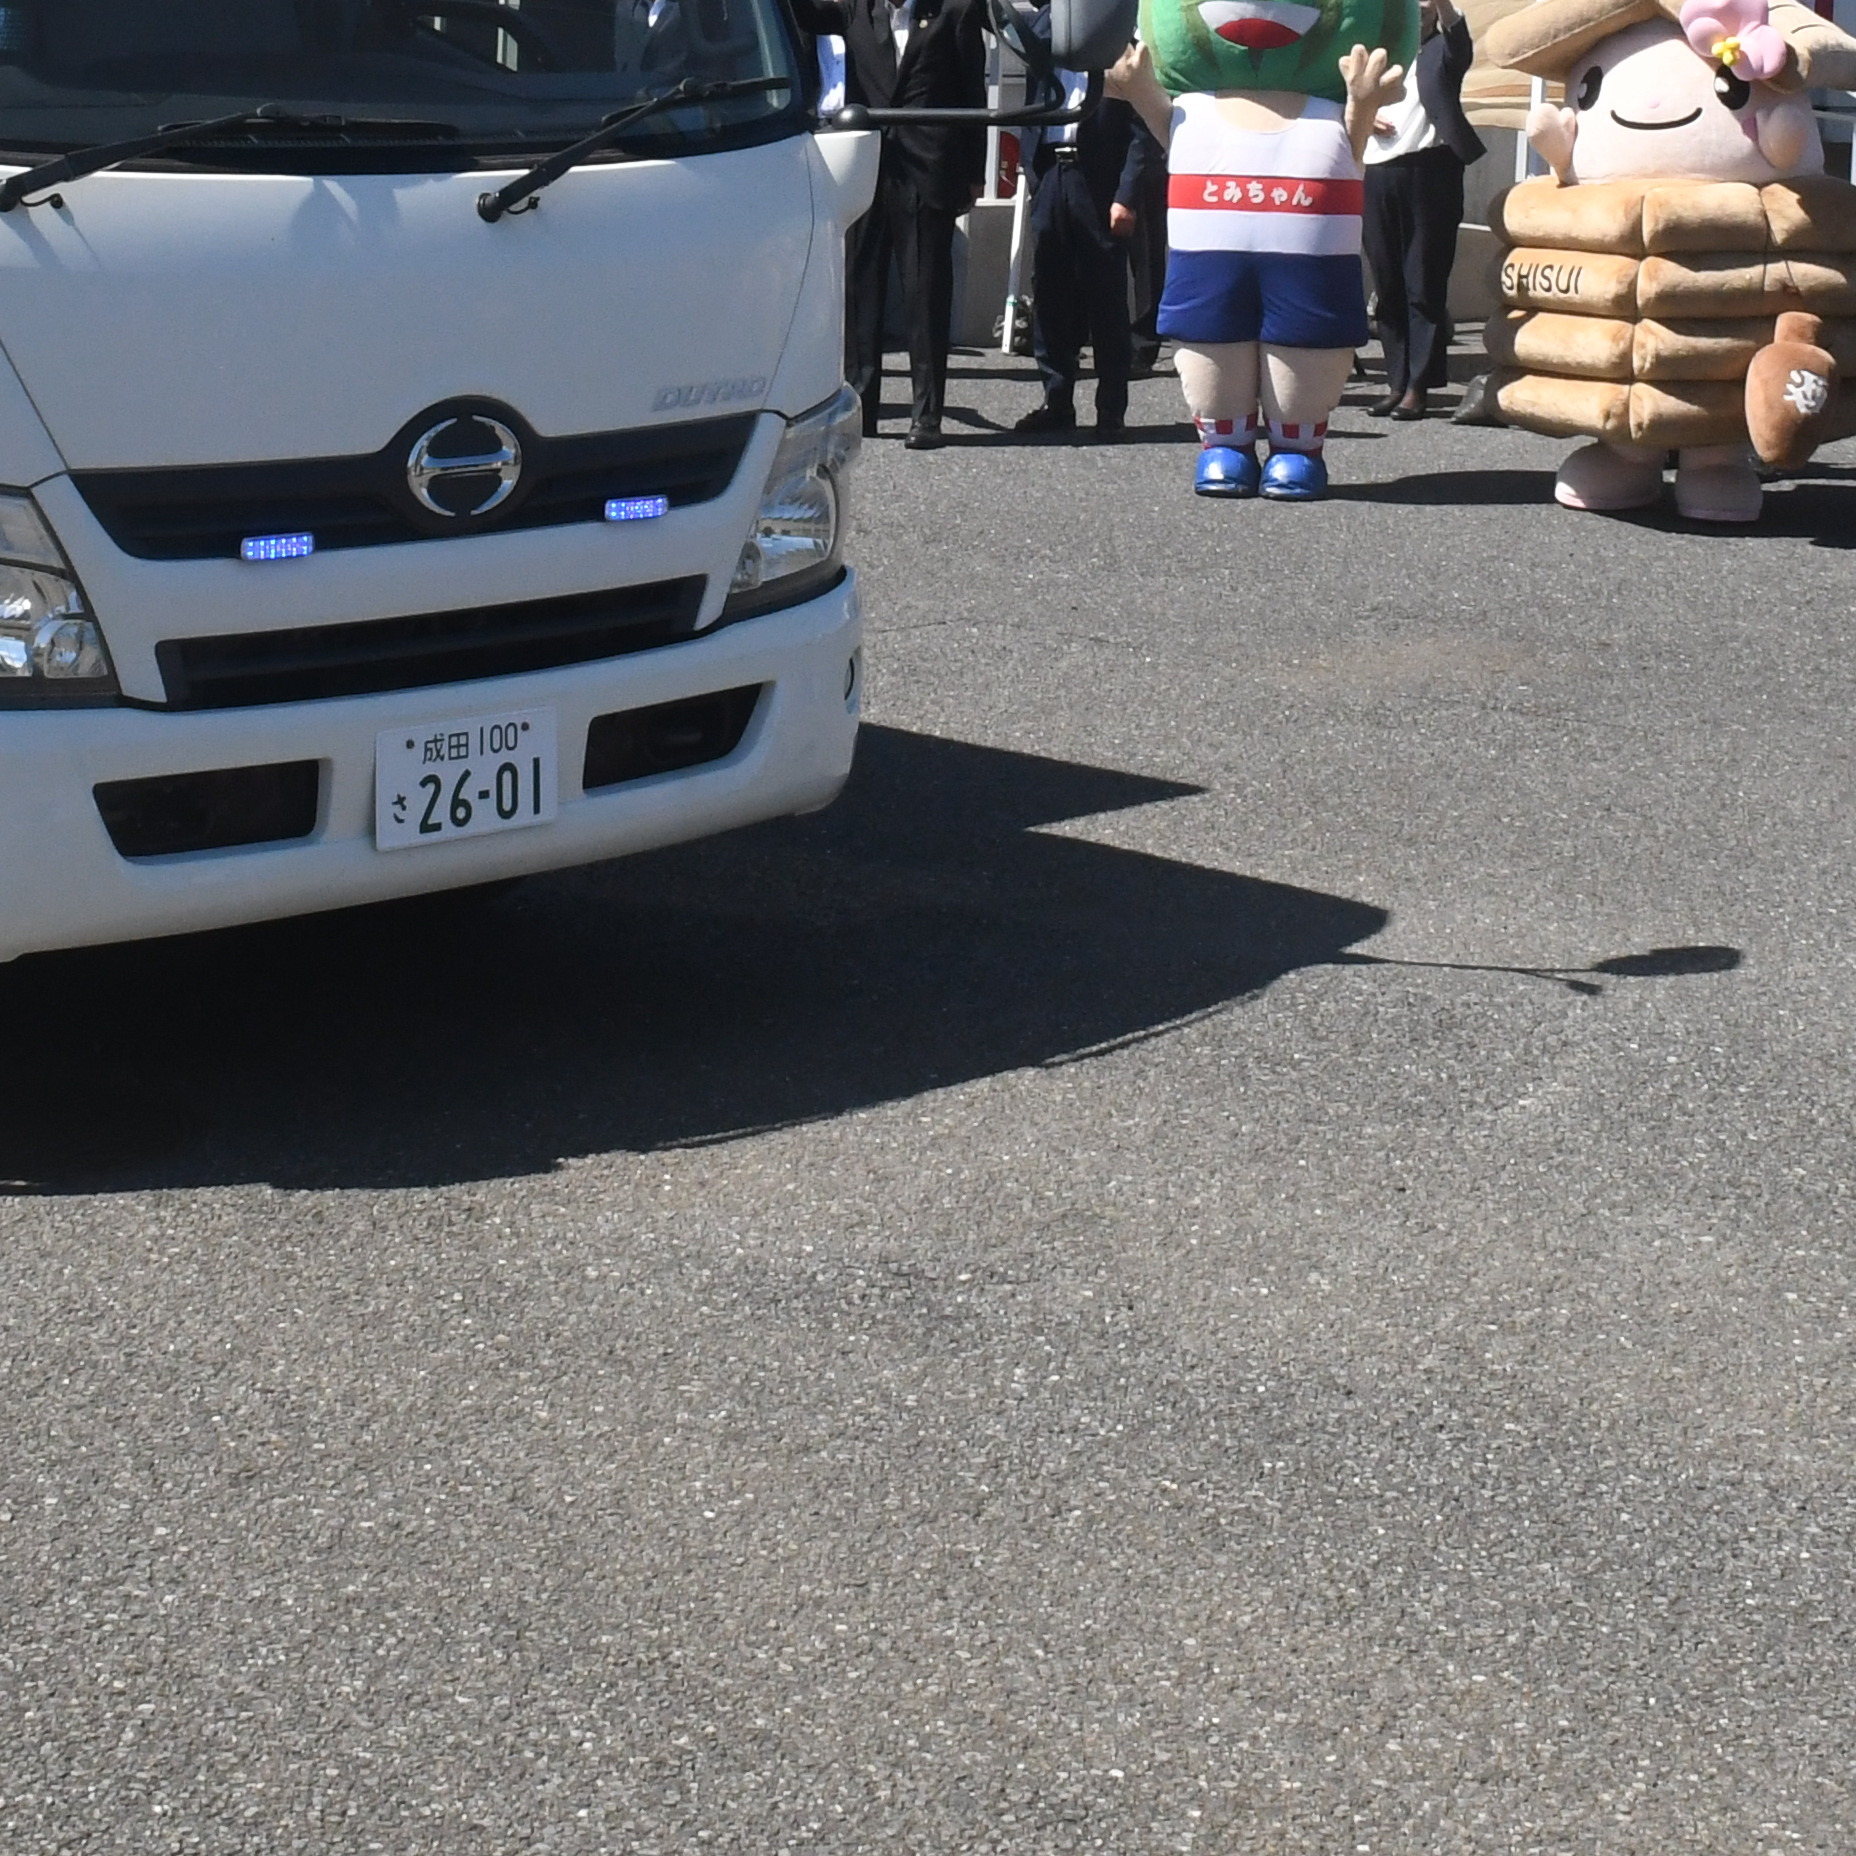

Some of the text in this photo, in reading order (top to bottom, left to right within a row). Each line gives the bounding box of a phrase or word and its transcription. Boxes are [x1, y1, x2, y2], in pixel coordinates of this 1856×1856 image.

[1202, 179, 1313, 207] とみちゃん
[1501, 262, 1583, 295] SHISUI
[422, 721, 519, 765] 成田 100
[391, 756, 541, 835] さ 26-01
